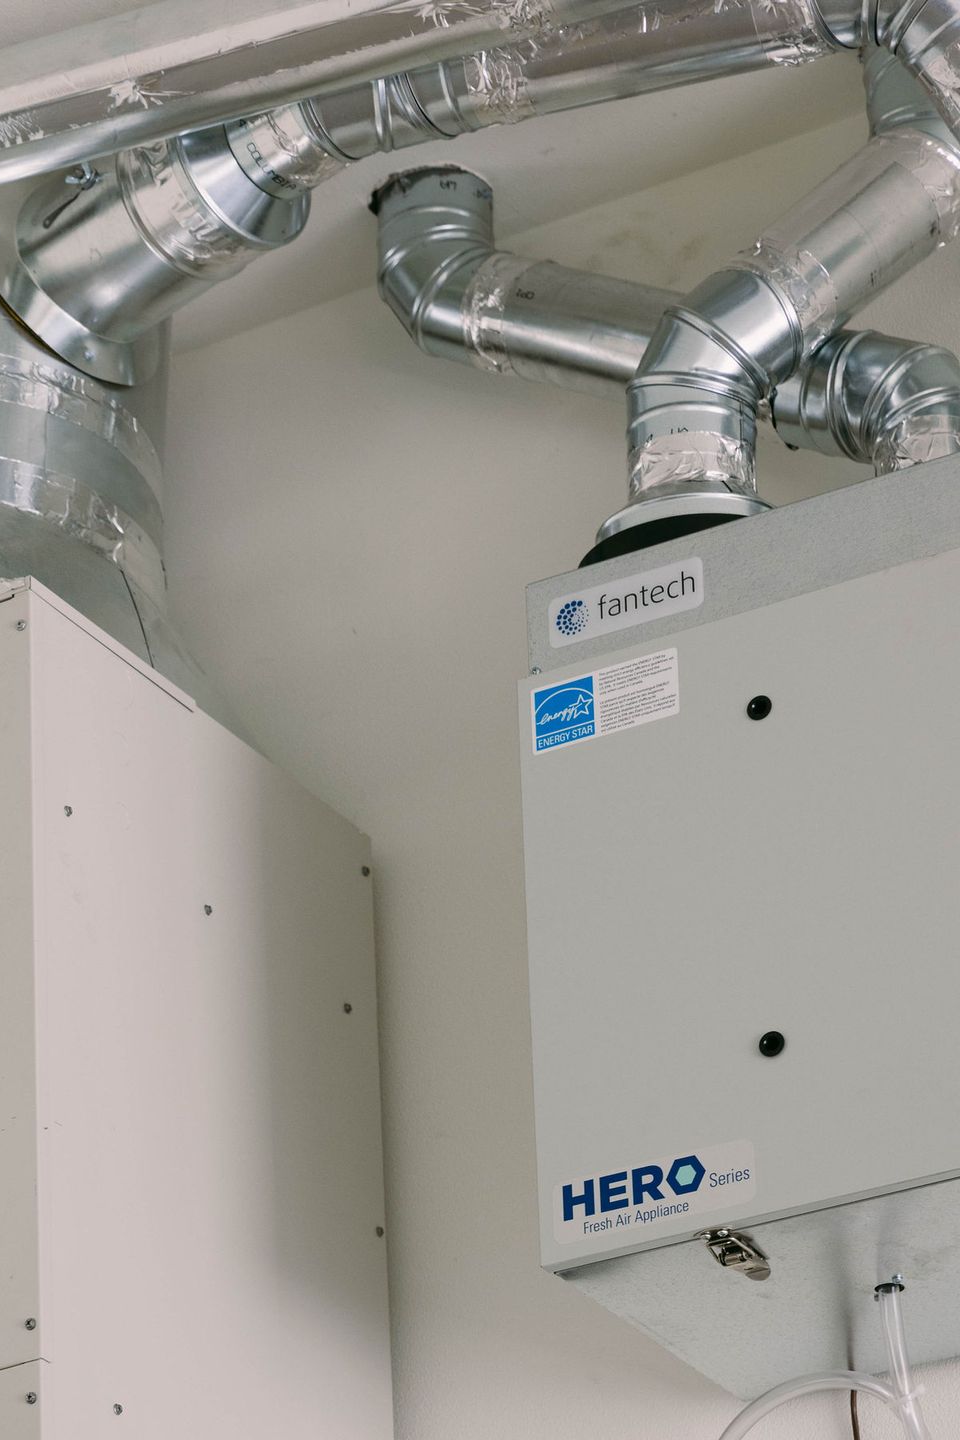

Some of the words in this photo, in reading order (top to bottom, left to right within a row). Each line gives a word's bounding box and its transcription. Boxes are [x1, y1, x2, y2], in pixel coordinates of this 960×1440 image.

[597, 571, 695, 620] fantech
[538, 731, 570, 748] ENERGY
[572, 724, 592, 738] STAR
[562, 1155, 706, 1222] HERO
[708, 1168, 751, 1188] Series
[584, 1216, 612, 1234] Fresh
[616, 1213, 631, 1226] Air
[635, 1201, 690, 1224] Appliance
